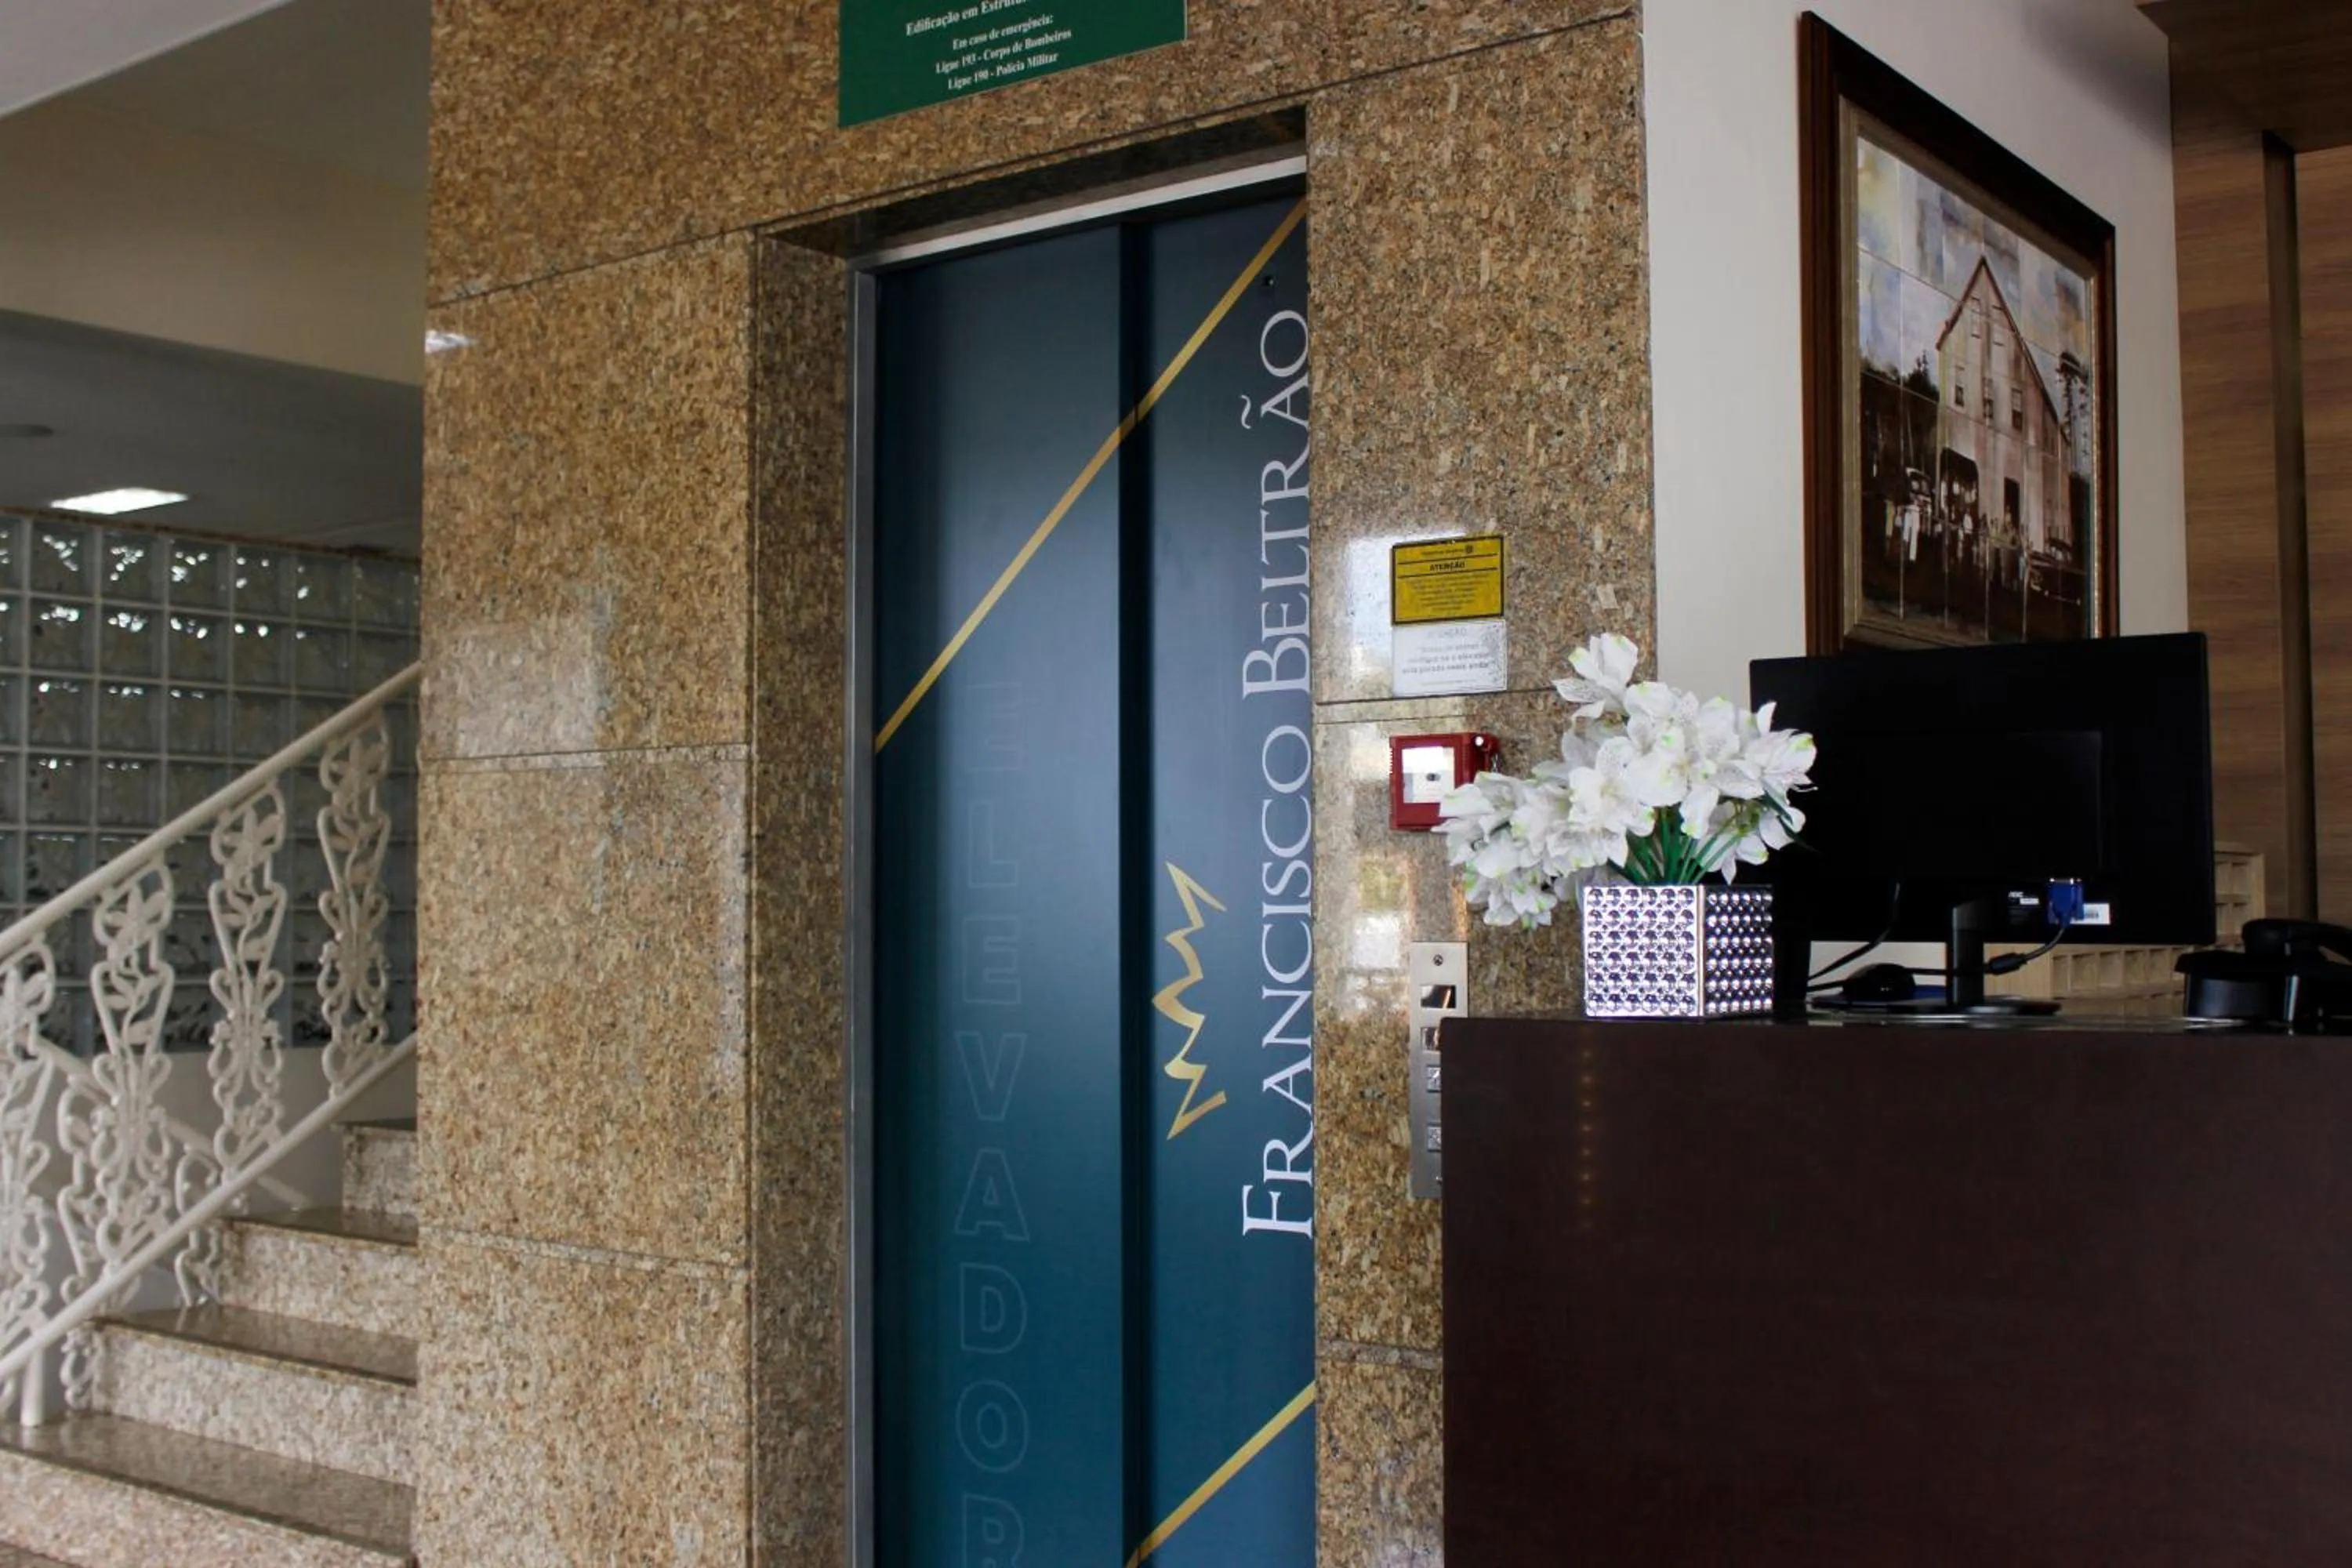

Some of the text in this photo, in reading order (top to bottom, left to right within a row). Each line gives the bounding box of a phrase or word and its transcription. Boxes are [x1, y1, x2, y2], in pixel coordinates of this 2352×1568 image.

[906, 11, 960, 36] Edificação
[962, 7, 978, 20] em
[953, 38, 967, 50] Em
[969, 34, 987, 45] caso
[989, 28, 999, 40] de
[935, 61, 959, 74] Ligue
[962, 53, 976, 67] 193
[983, 47, 1010, 60] Corpo
[1012, 42, 1022, 53] de
[1025, 30, 1072, 49] Bombeiros
[948, 77, 971, 90] Ligue
[975, 70, 989, 83] 190
[1027, 53, 1058, 68] Militar
[1241, 310, 1313, 1239] FRANCISCO BELTRÃO
[954, 681, 1030, 1568] ELEVADOR
